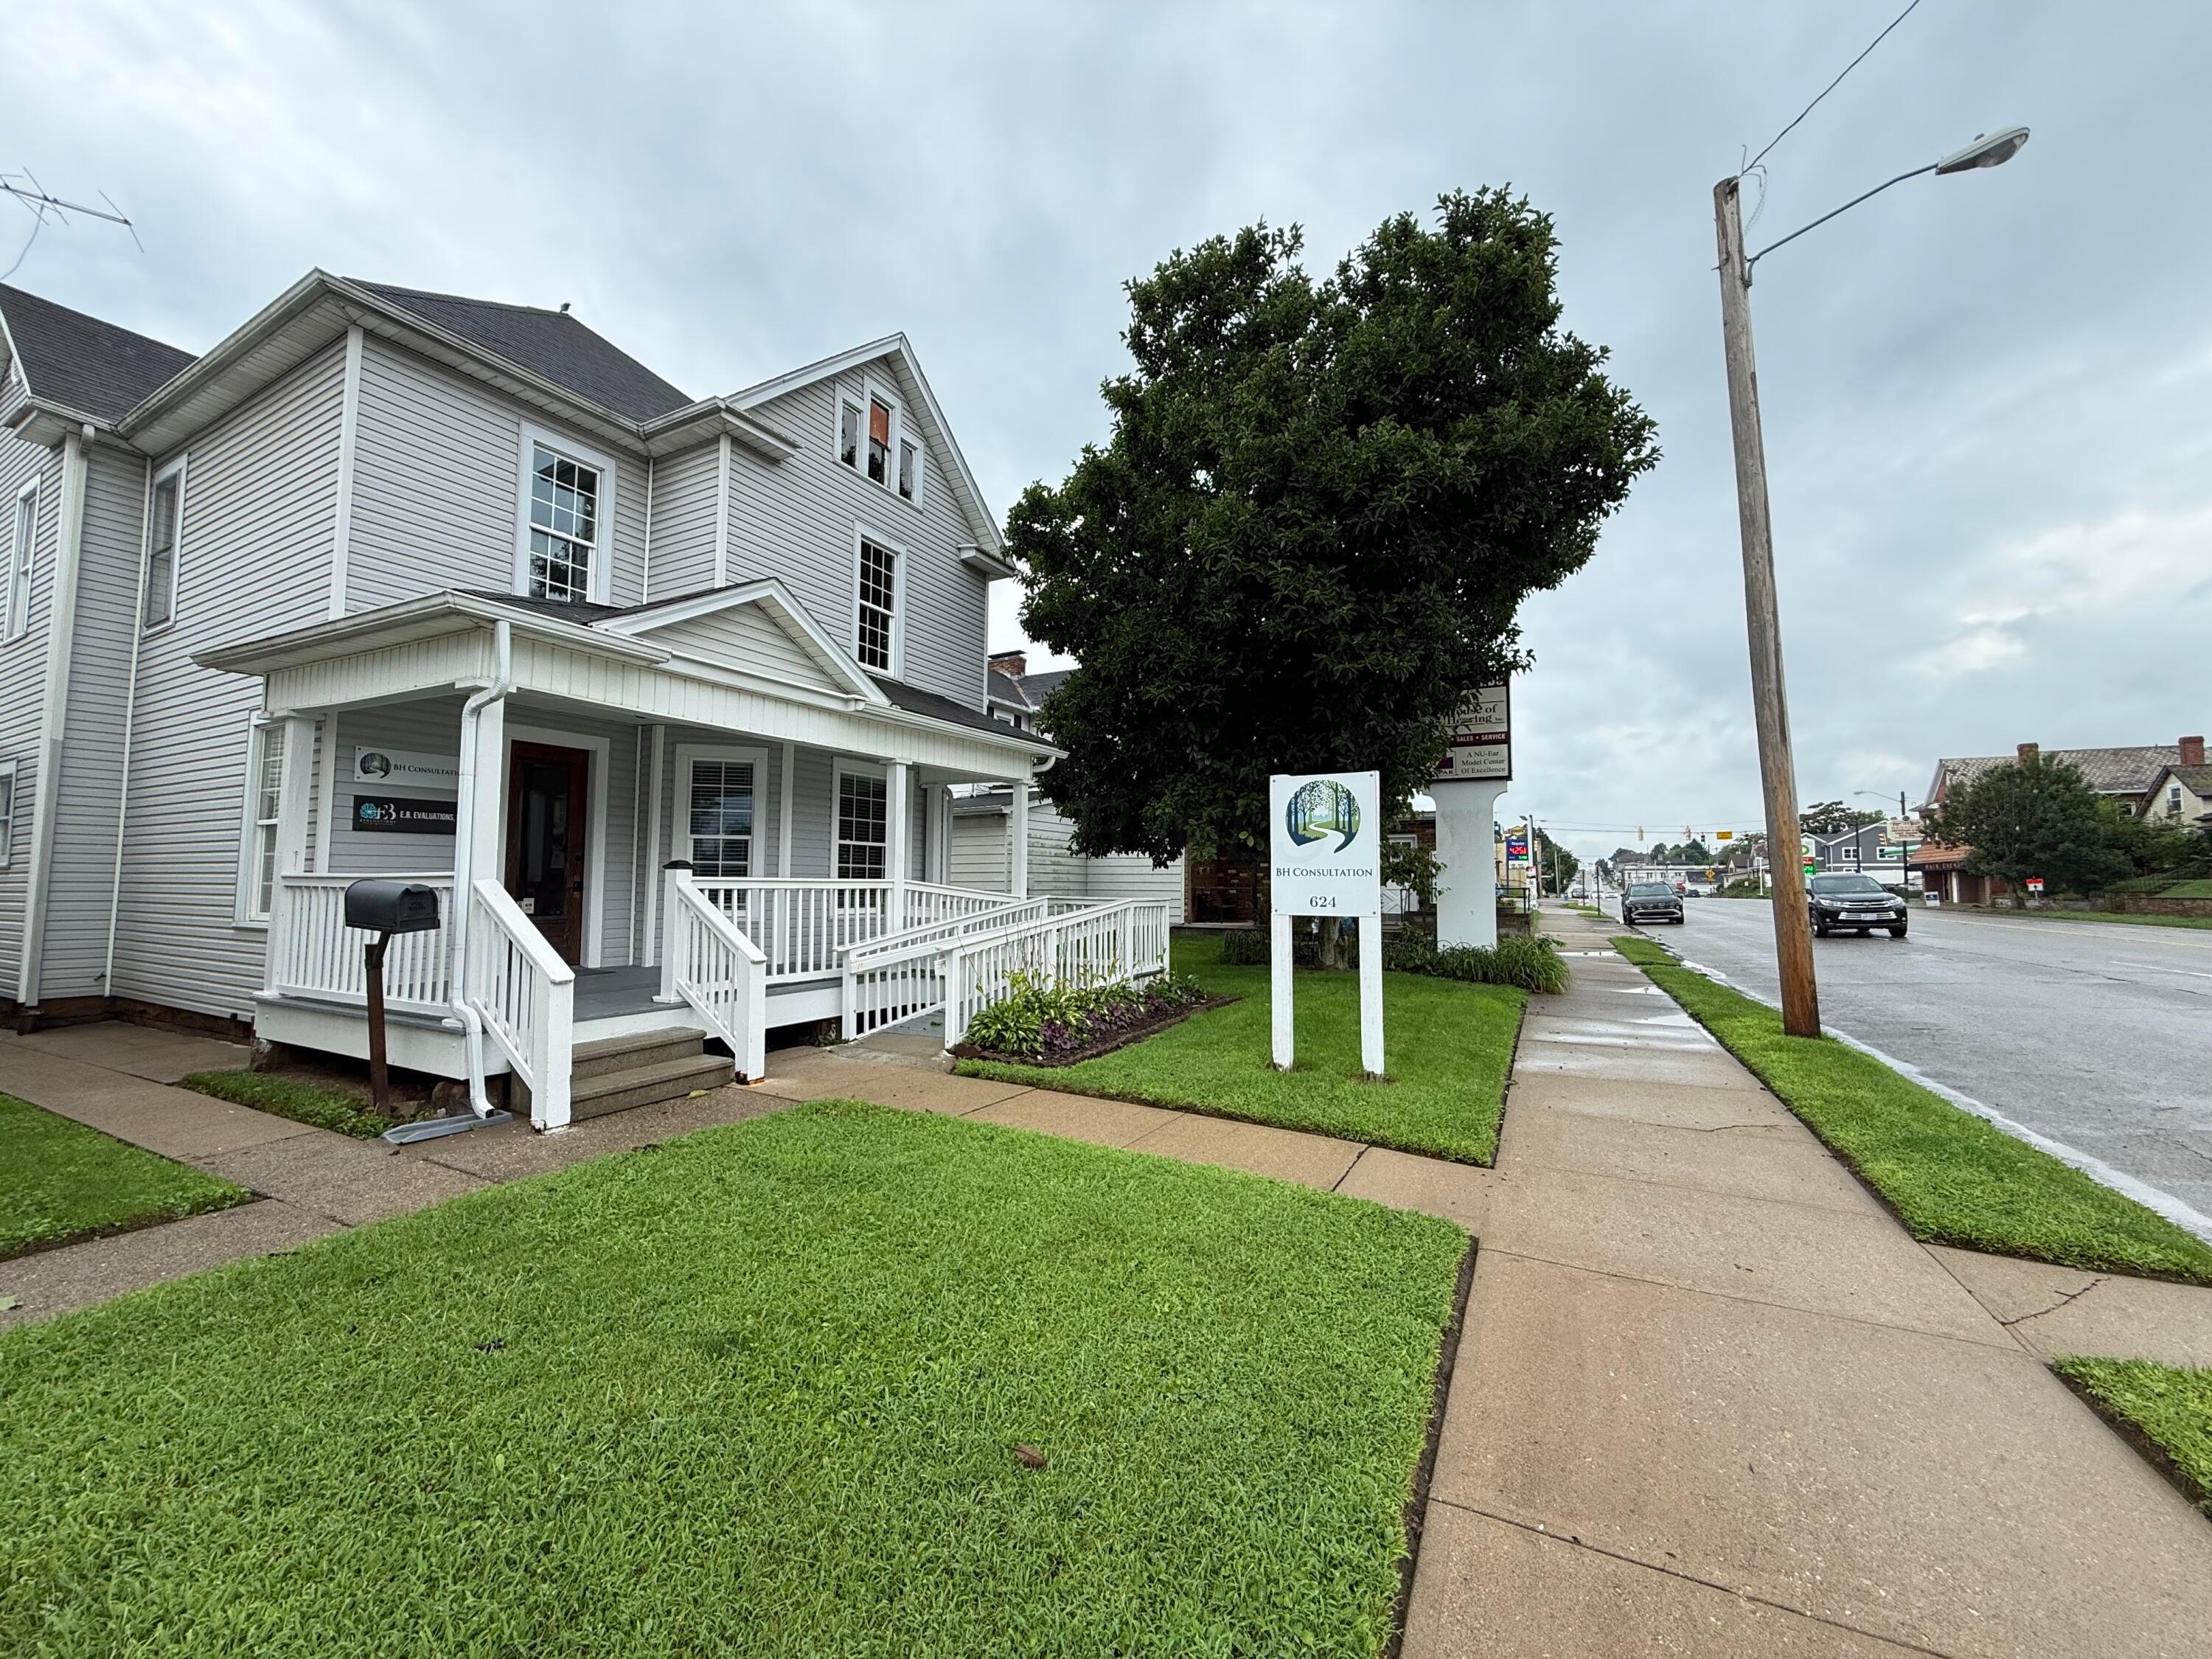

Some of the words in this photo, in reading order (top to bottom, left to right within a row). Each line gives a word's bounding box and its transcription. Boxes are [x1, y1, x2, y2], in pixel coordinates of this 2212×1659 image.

[1485, 704, 1498, 713] of
[400, 810, 412, 819] E.B.
[1276, 867, 1290, 877] BH
[1293, 867, 1373, 877] CONSULTATION
[1310, 896, 1337, 908] 624
